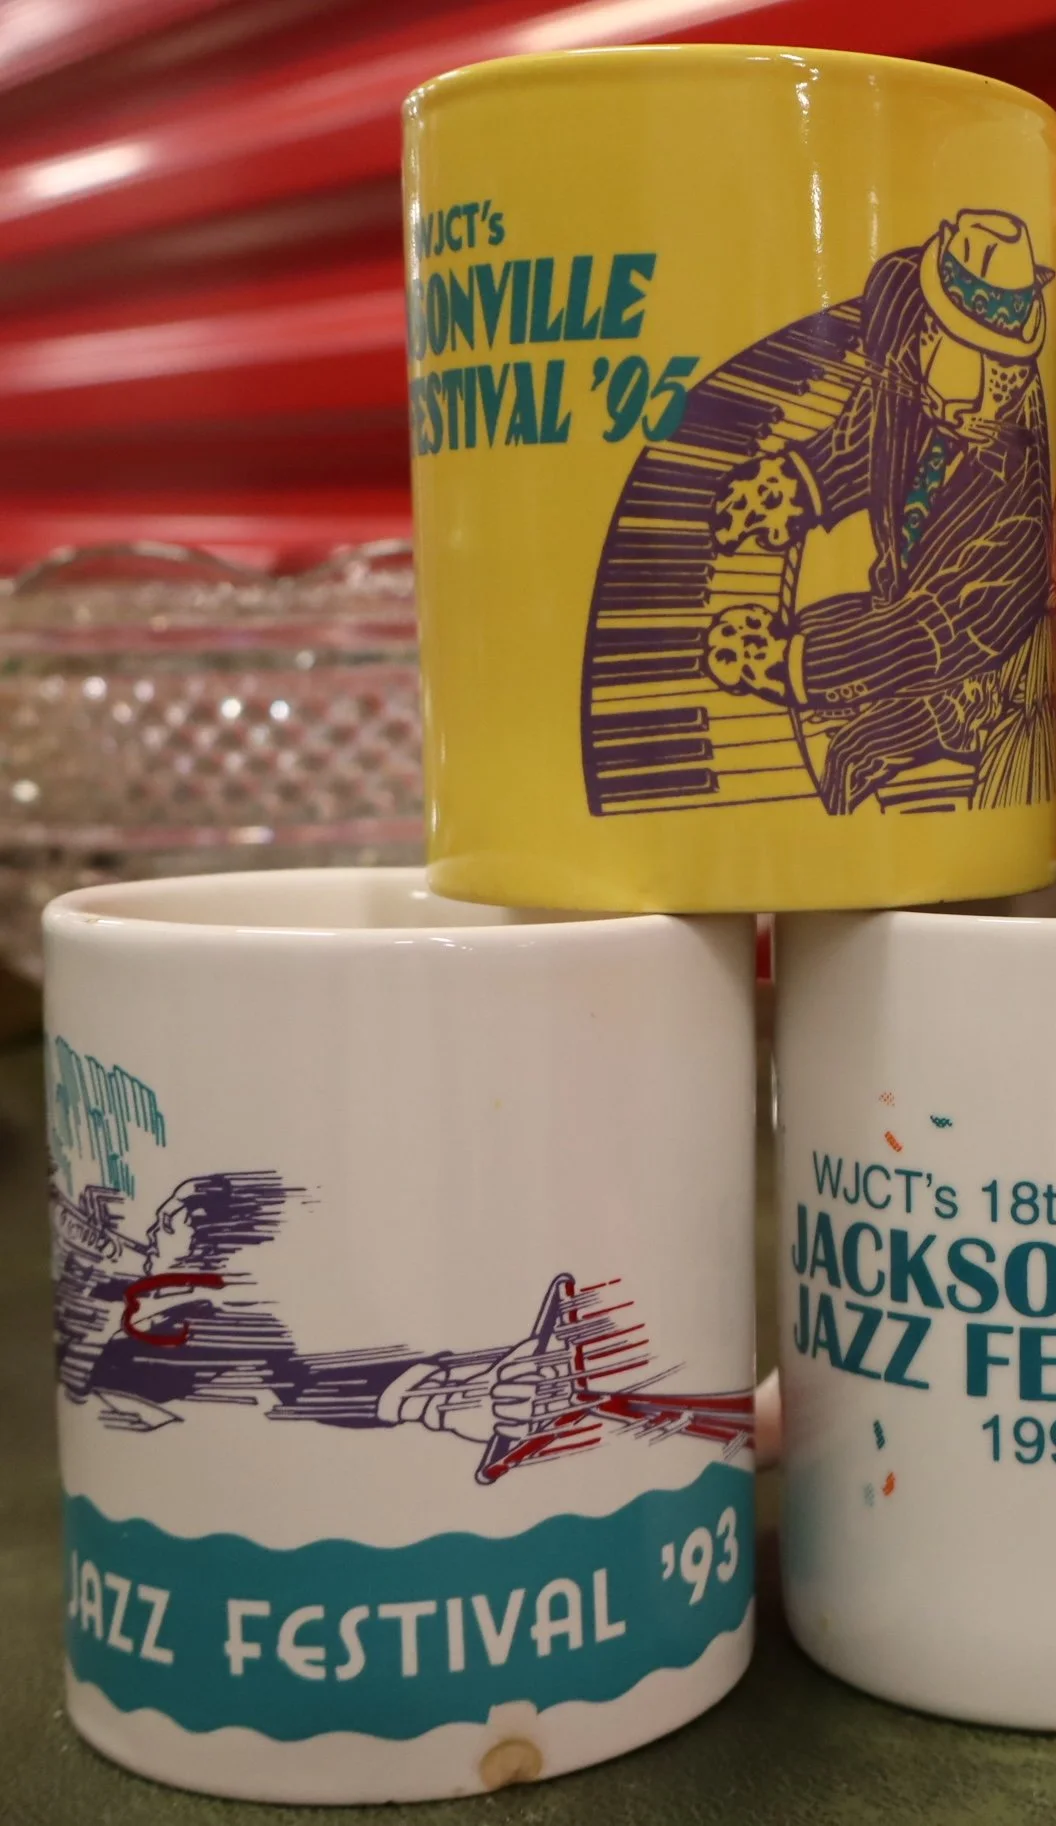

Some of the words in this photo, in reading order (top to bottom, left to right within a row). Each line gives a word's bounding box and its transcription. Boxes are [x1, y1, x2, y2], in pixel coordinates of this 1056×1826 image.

[812, 1150, 959, 1219] WJCT's
[793, 1284, 932, 1391] JAZZ
[68, 1549, 175, 1666] JAZZ
[224, 1568, 627, 1682] FESTIVAL
[661, 1506, 739, 1607] '93
